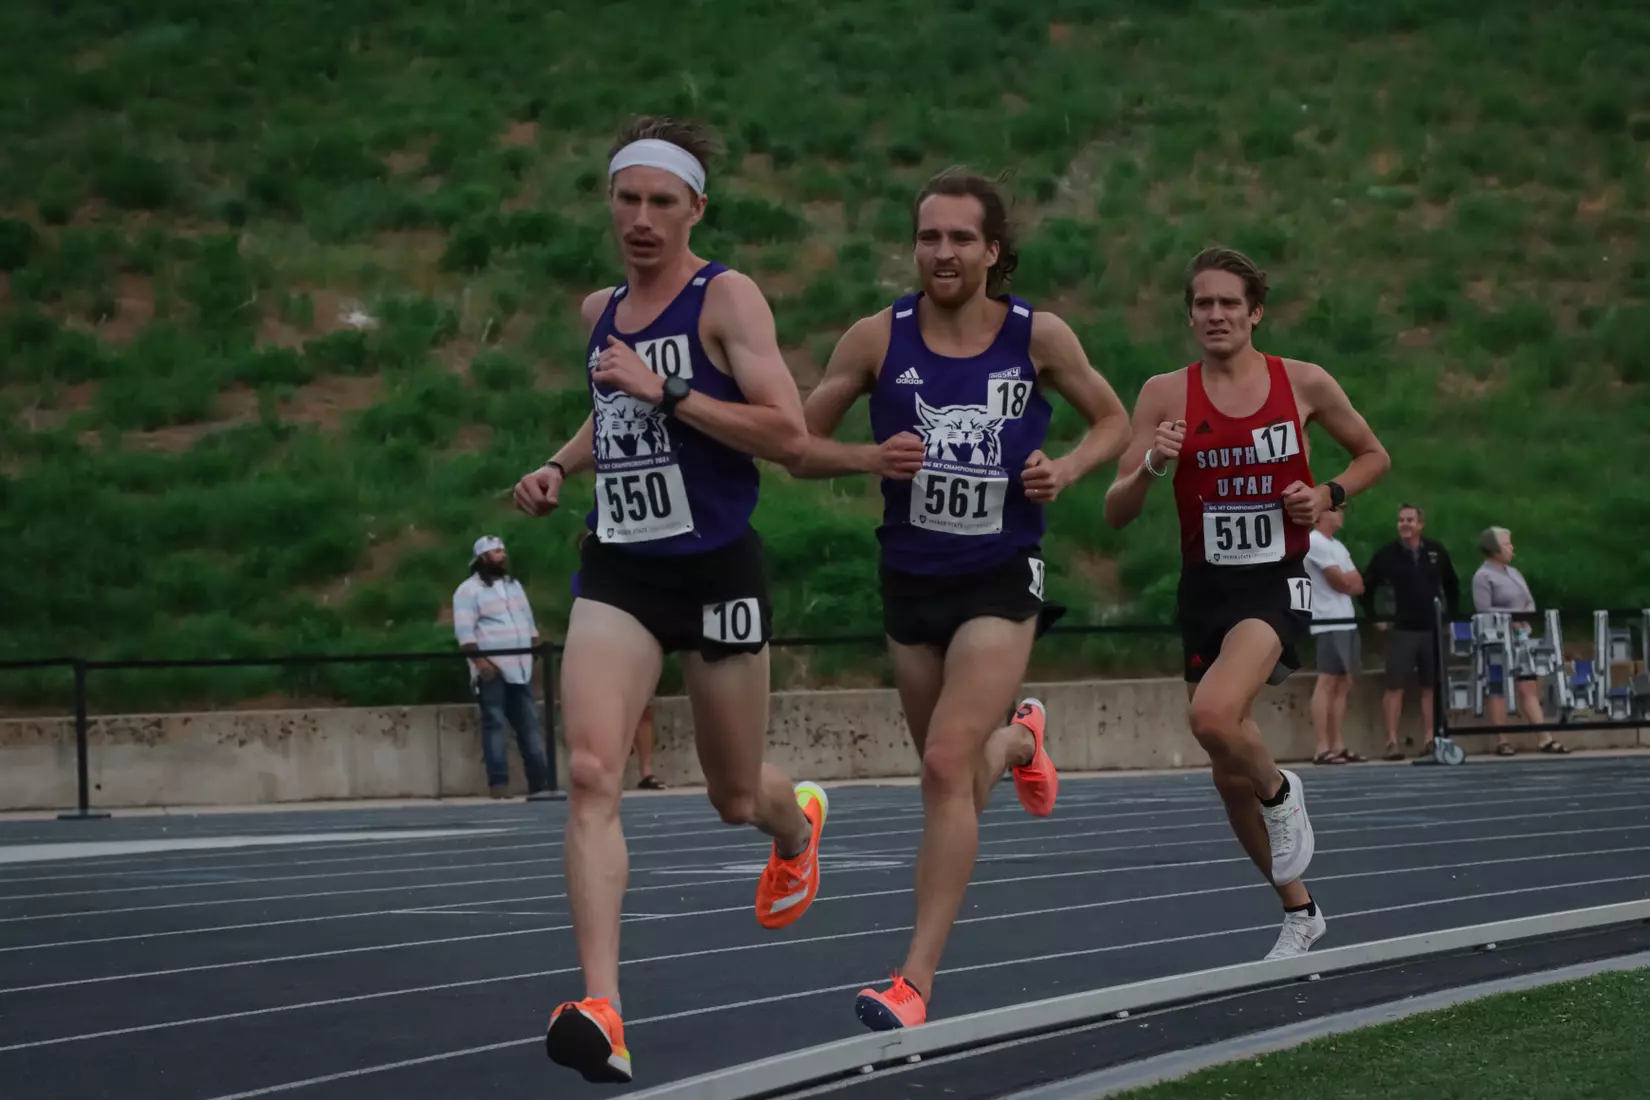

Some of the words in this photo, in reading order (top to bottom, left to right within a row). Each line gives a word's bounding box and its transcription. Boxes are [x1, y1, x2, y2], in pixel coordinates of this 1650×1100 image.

[645, 338, 681, 377] 10
[896, 377, 924, 385] adidas
[996, 381, 1027, 417] 18
[1196, 446, 1289, 469] SOUTH
[1260, 424, 1287, 458] 17
[605, 470, 672, 524] 550
[924, 473, 989, 519] 561
[1217, 475, 1273, 497] UTAH
[1215, 514, 1272, 551] 510
[713, 600, 751, 641] 10
